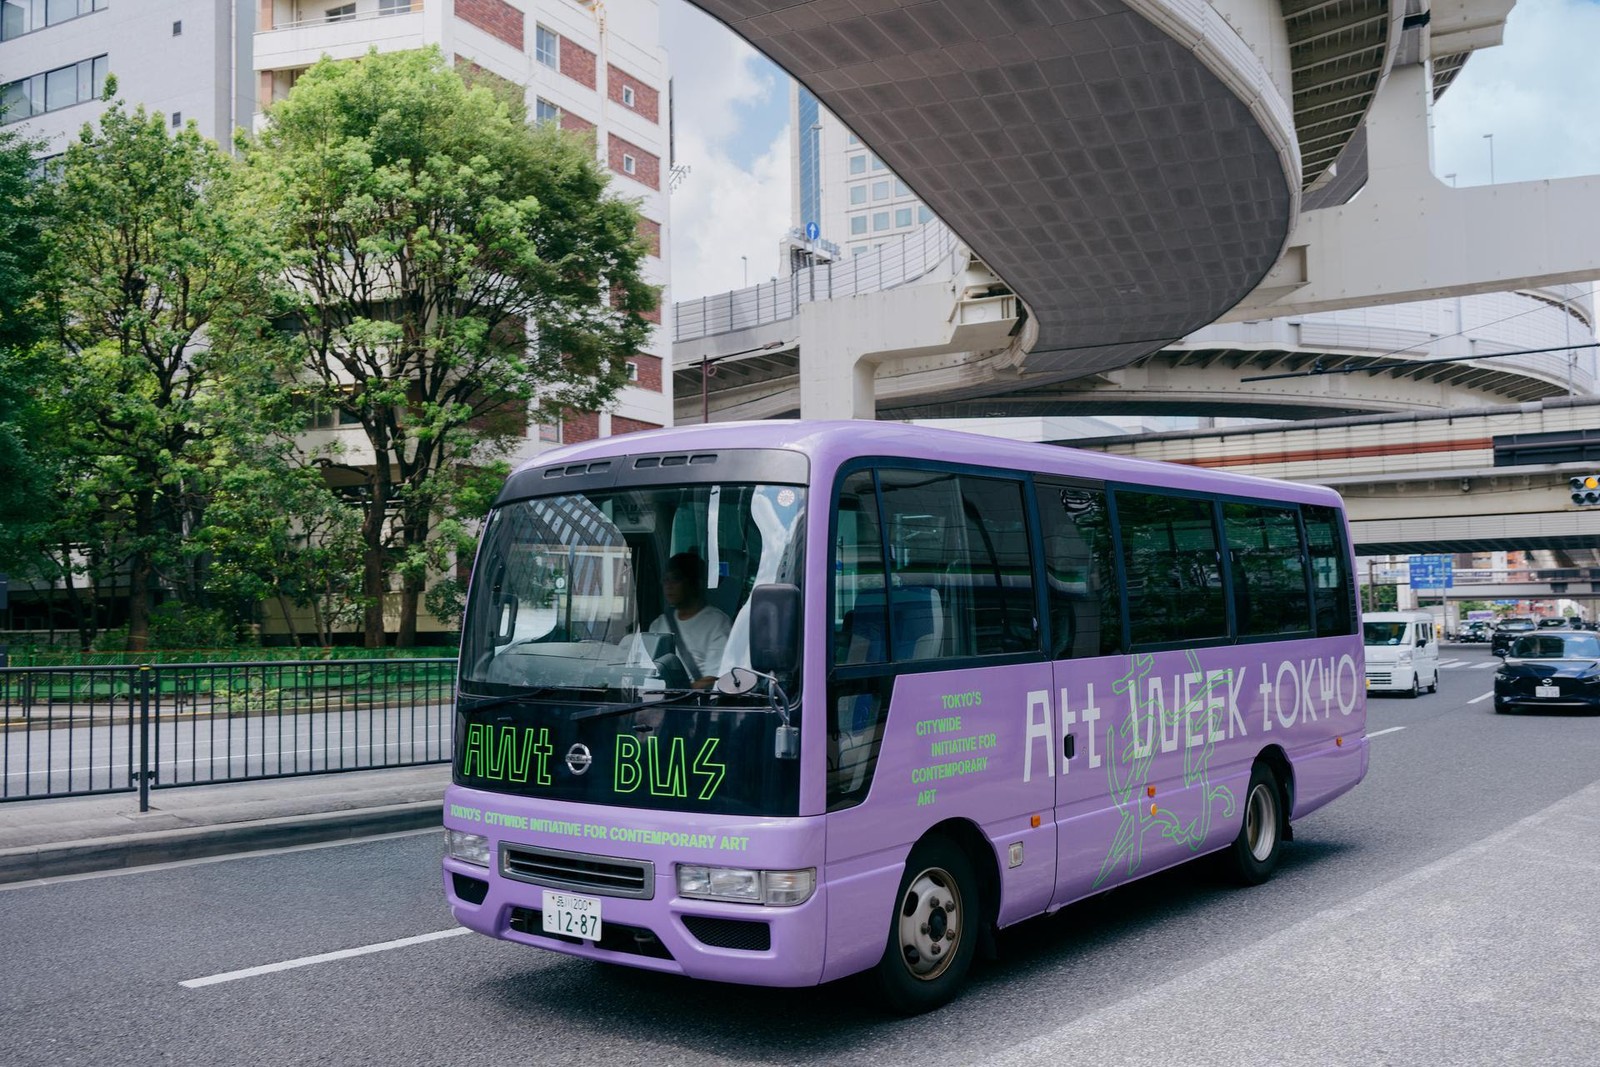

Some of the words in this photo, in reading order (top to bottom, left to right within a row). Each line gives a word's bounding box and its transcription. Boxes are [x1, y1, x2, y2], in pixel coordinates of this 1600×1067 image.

[942, 691, 982, 710] TOKYO'S
[1128, 667, 1248, 759] WEEK
[916, 716, 962, 736] CITYWIDE
[931, 736, 977, 758] INITIATIVE
[978, 733, 997, 749] FOR
[613, 734, 726, 800] BUS
[911, 757, 988, 784] CONTEMPORARY
[917, 789, 937, 806] ART
[450, 803, 482, 822] TOKYO'S
[484, 810, 529, 830] CITYWIDE
[529, 817, 582, 837] INITIATIVE
[583, 823, 608, 839] FOR
[609, 826, 717, 849] CONTEMPORARY
[719, 835, 750, 851] ART
